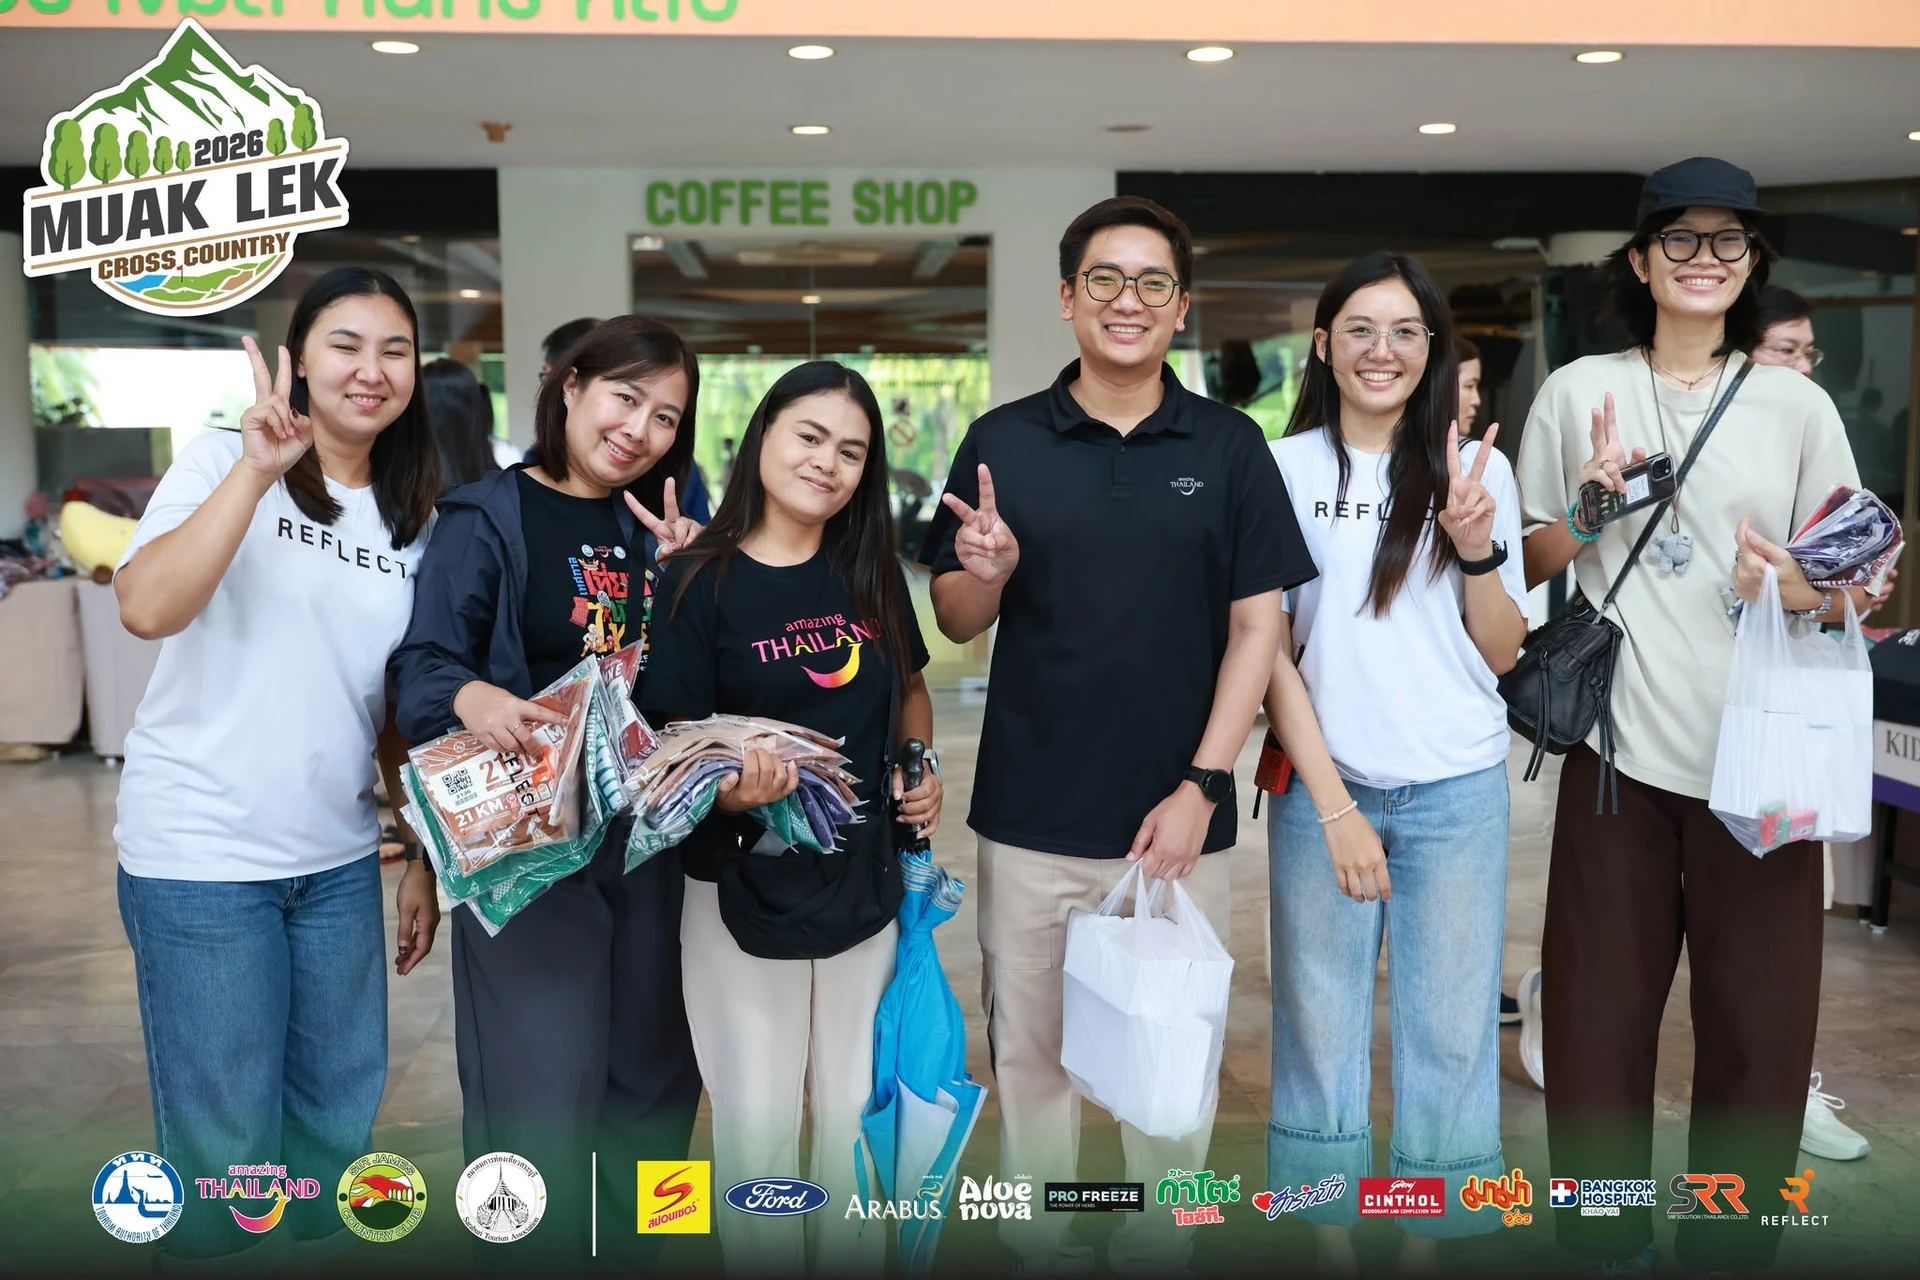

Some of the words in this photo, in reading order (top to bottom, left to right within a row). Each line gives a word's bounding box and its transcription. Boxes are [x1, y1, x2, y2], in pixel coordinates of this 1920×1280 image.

[645, 180, 830, 226] COFFEE
[852, 180, 979, 225] SHOP
[277, 516, 408, 580] REFLECT
[785, 613, 847, 632] amazing
[454, 810, 474, 828] 21
[475, 798, 509, 820] KM.
